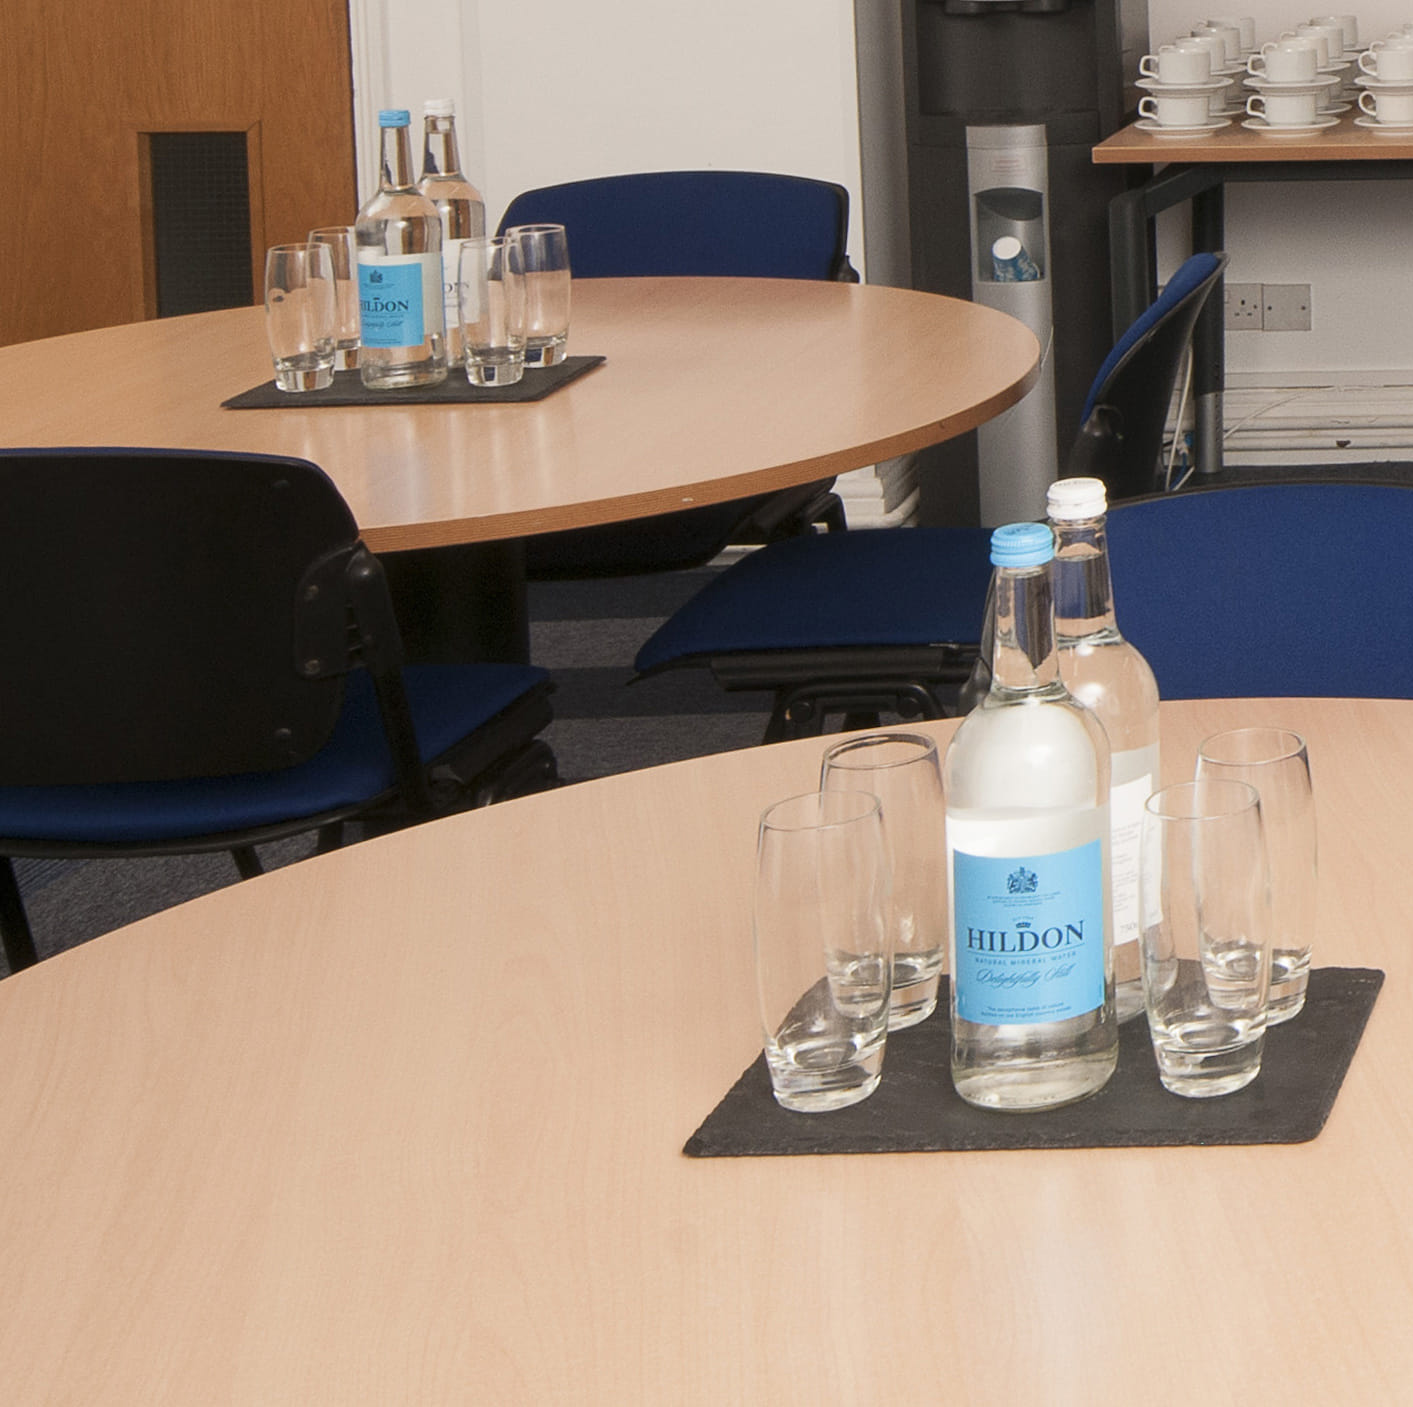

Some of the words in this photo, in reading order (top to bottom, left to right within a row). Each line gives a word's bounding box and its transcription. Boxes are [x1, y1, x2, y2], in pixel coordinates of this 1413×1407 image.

[967, 920, 1084, 953] HILDON
[975, 957, 1007, 966] NATURAL
[1010, 958, 1046, 966] MINERAL
[1051, 951, 1076, 961] WATER
[976, 967, 1042, 989] Delightfully
